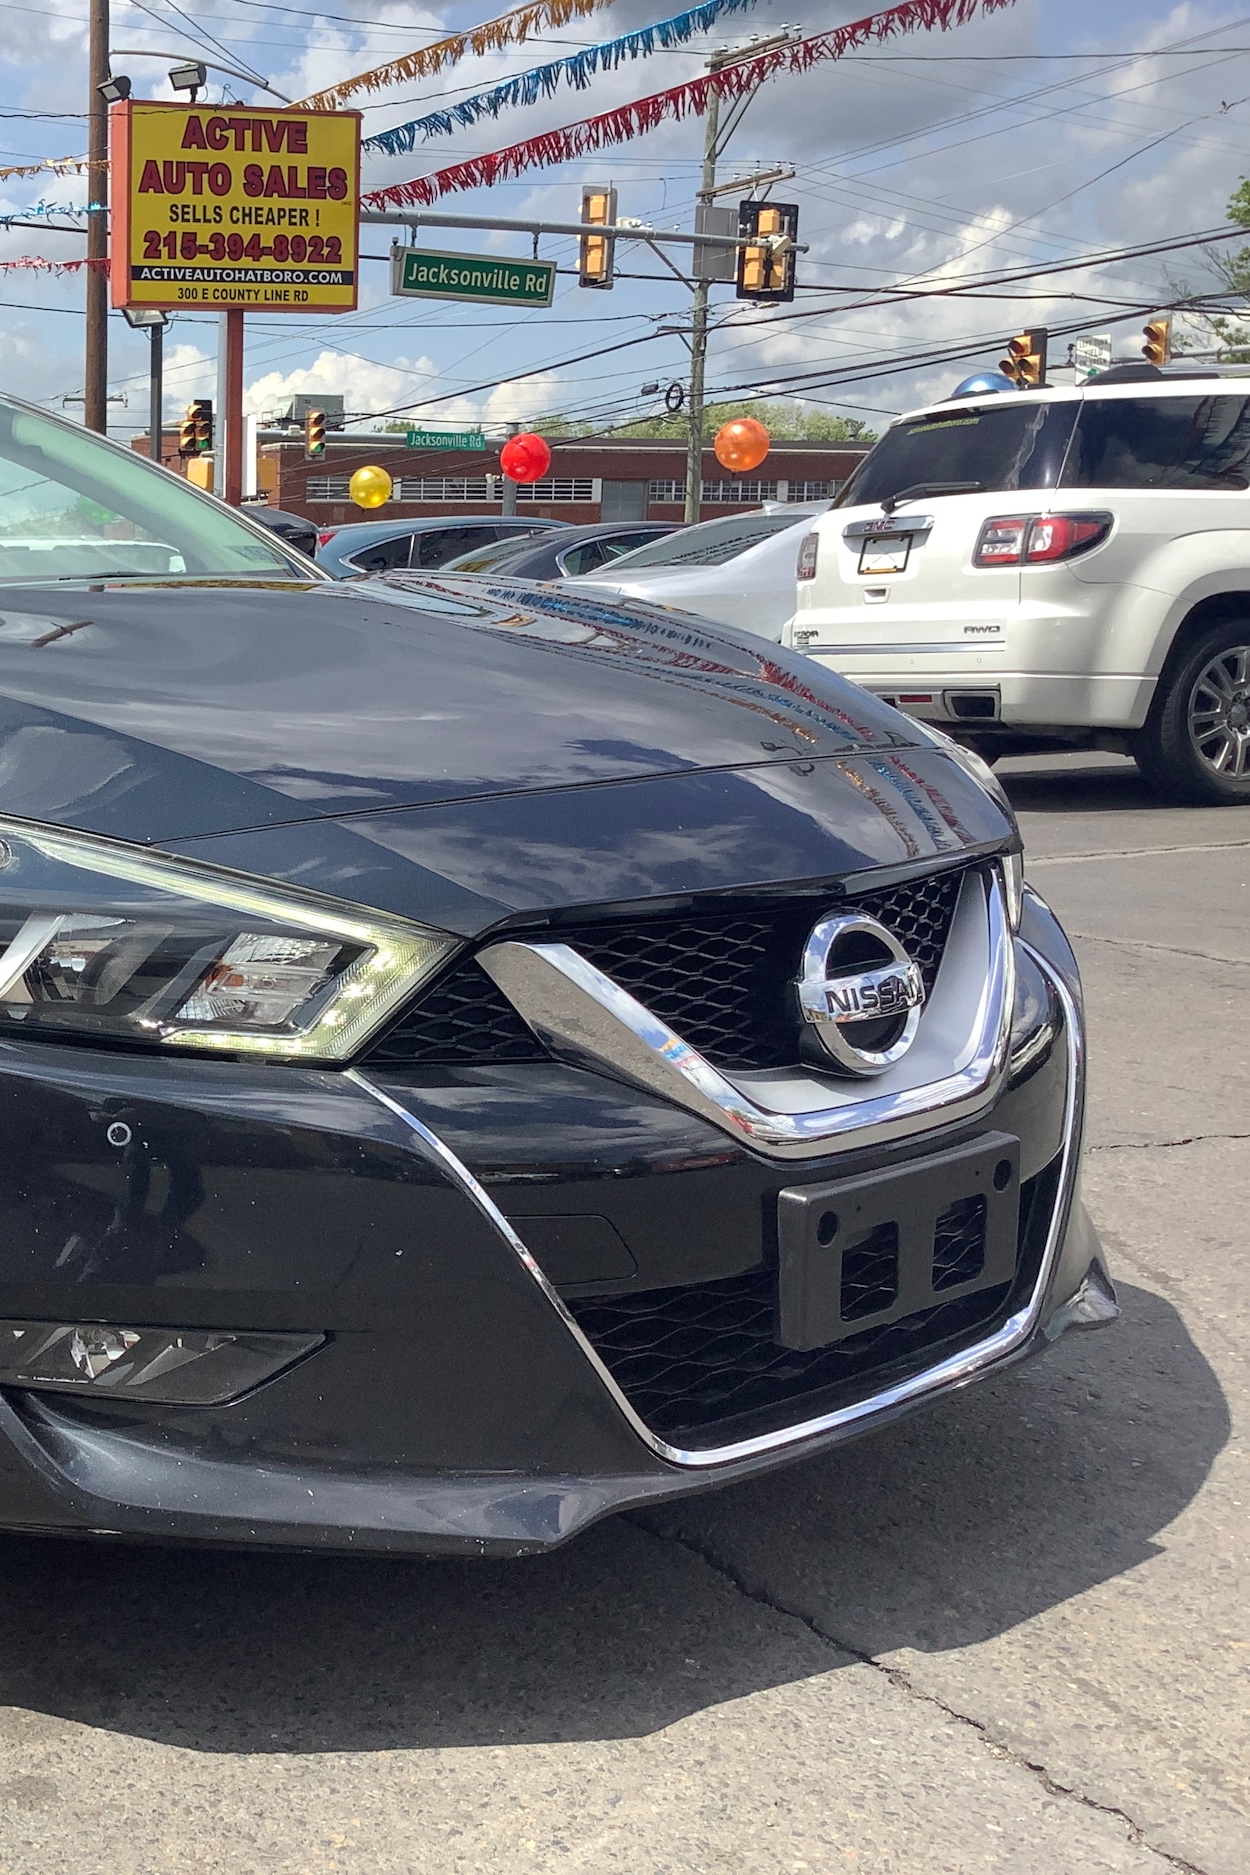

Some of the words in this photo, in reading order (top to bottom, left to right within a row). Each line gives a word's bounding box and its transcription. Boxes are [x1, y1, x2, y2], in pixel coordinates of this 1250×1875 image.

[181, 115, 308, 154] ACTIVE
[138, 159, 232, 197] AUTO
[243, 163, 348, 201] SALES
[169, 204, 223, 224] SELLS
[229, 205, 310, 227] CHEAPER
[143, 230, 342, 264] 215-394-8922
[140, 267, 343, 284] ACTIVEAUTOHATBORO.COM
[408, 262, 520, 291] Jacksonville
[525, 273, 547, 293] Rd
[177, 287, 198, 300] 300
[202, 288, 209, 300] E
[212, 288, 260, 301] COUNTY
[263, 289, 290, 302] LINE
[293, 290, 309, 302] RD
[410, 432, 468, 448] Jacksonville
[469, 434, 482, 448] Rd
[863, 520, 895, 532] GMC
[824, 973, 923, 1014] NISSAN
